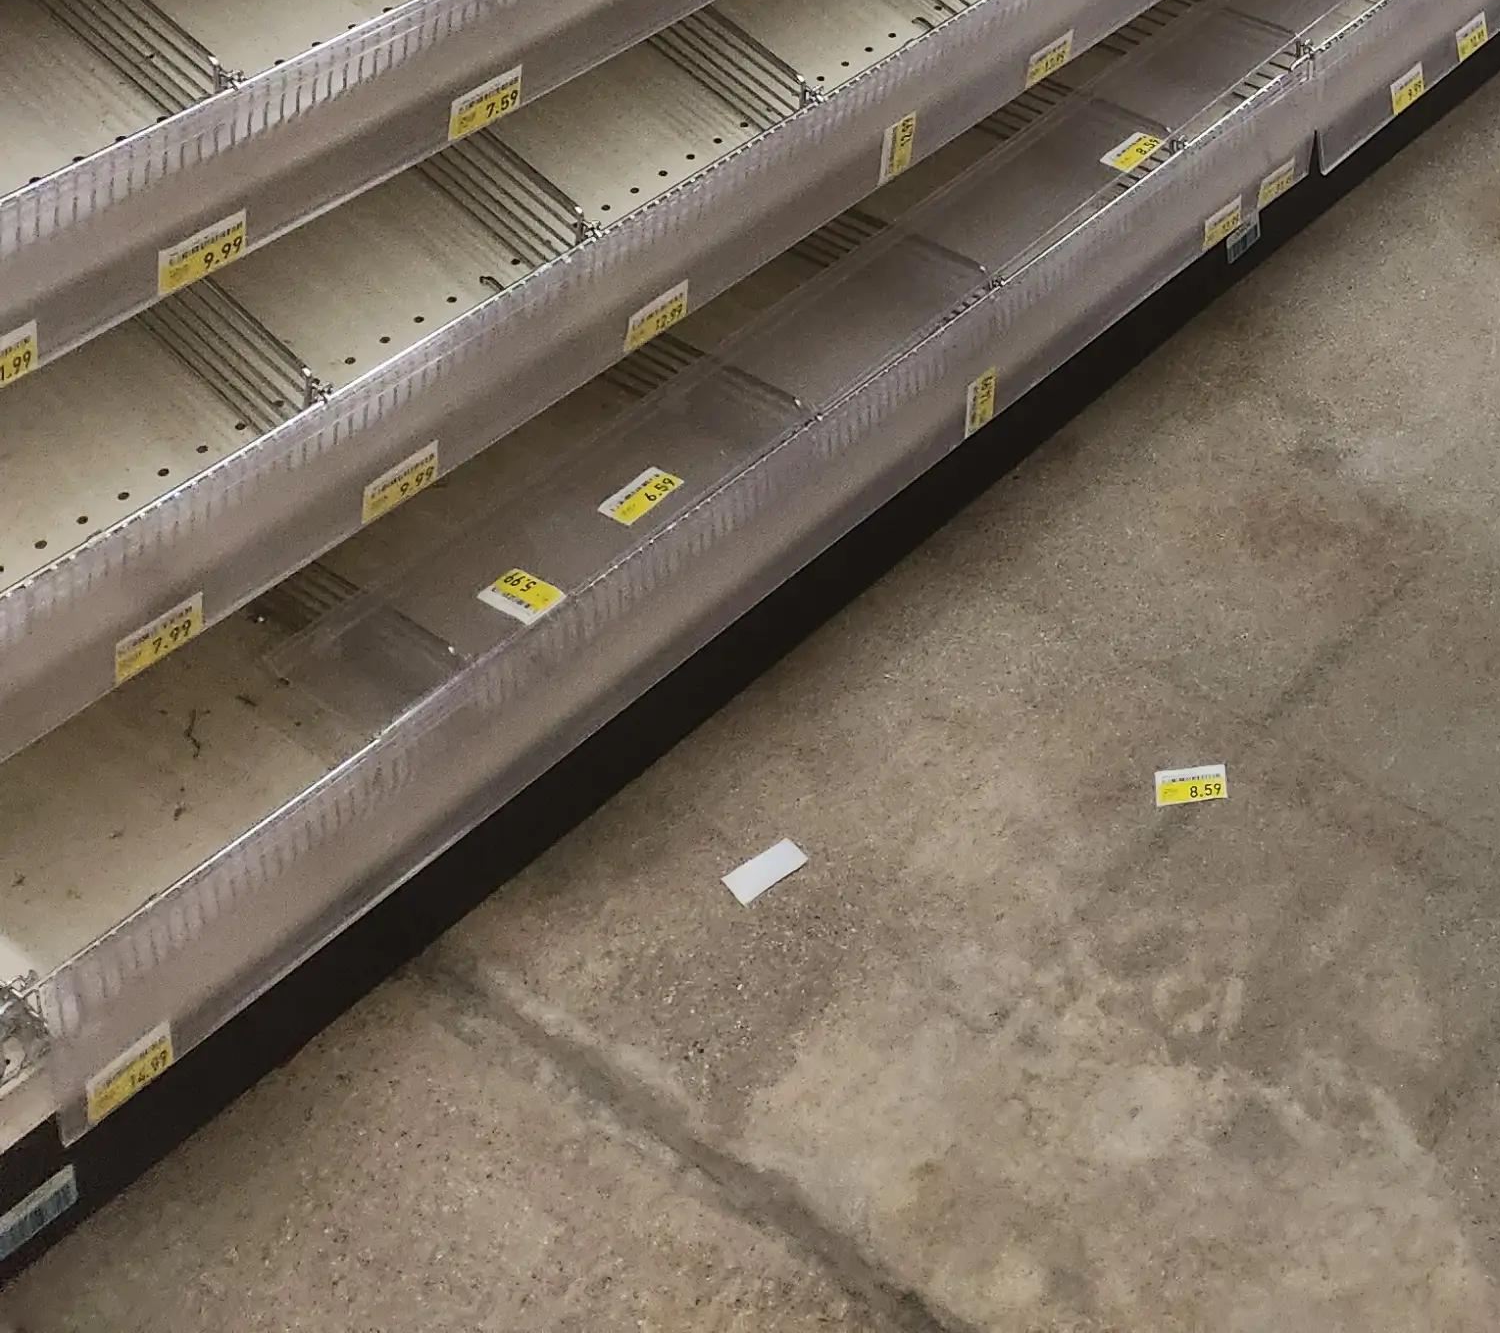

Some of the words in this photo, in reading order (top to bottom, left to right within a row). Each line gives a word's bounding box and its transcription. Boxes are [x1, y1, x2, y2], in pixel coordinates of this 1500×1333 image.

[486, 90, 519, 117] 7.59
[1135, 137, 1160, 156] 8.59
[203, 237, 243, 270] 9.99
[400, 466, 434, 496] 9.99
[645, 477, 675, 502] 6.59
[503, 571, 537, 593] 5.99
[153, 619, 192, 655] 7.99
[1188, 782, 1222, 800] 8.59
